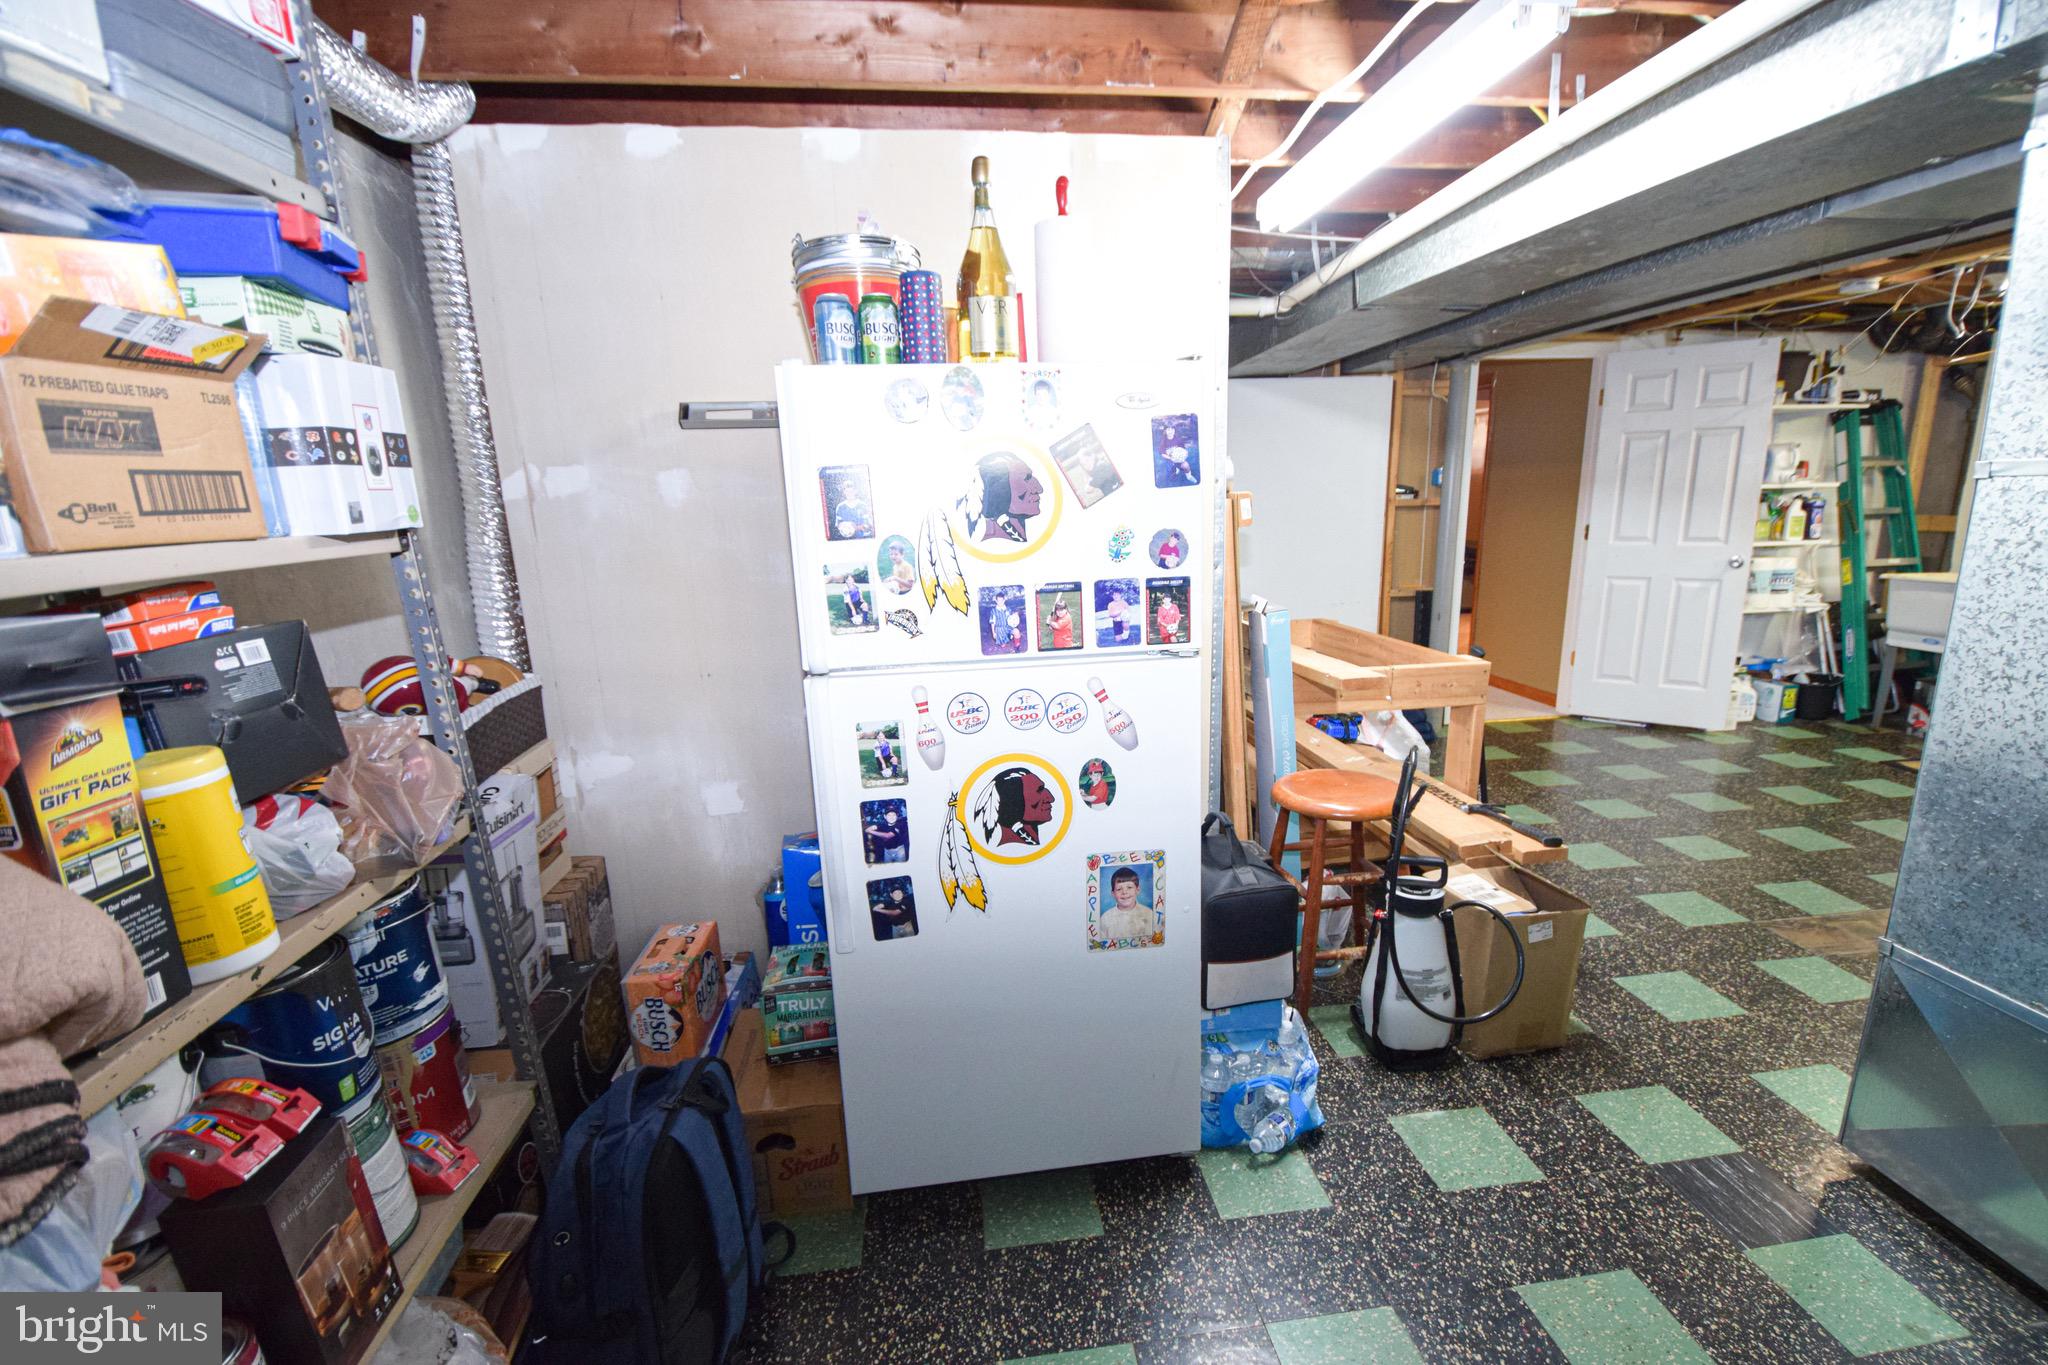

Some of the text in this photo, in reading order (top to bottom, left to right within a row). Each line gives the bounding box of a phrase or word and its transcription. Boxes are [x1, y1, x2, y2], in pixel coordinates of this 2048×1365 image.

[826, 322, 855, 335] BUSC
[19, 374, 169, 400] 72 PREBAITED GLUE TRAPS
[63, 416, 141, 443] MAX
[87, 502, 117, 513] Bell
[950, 706, 984, 718] USBC
[1007, 703, 1040, 713] USBC
[1051, 704, 1081, 720] USBC
[956, 715, 981, 727] 175
[1010, 712, 1039, 722] 200
[81, 772, 99, 782] CAR
[41, 771, 132, 811] GIFT PACK
[1103, 852, 1140, 864] BEE
[1087, 873, 1098, 937] APPLE
[1155, 875, 1164, 925] CAT
[355, 949, 409, 978] ATURE
[777, 997, 827, 1014] TRULY
[645, 998, 670, 1052] BUSCH
[216, 1125, 242, 1142] Scotch
[778, 1143, 840, 1181] Straub
[287, 1197, 309, 1223] PIECE
[310, 1161, 339, 1196] WHISKEY
